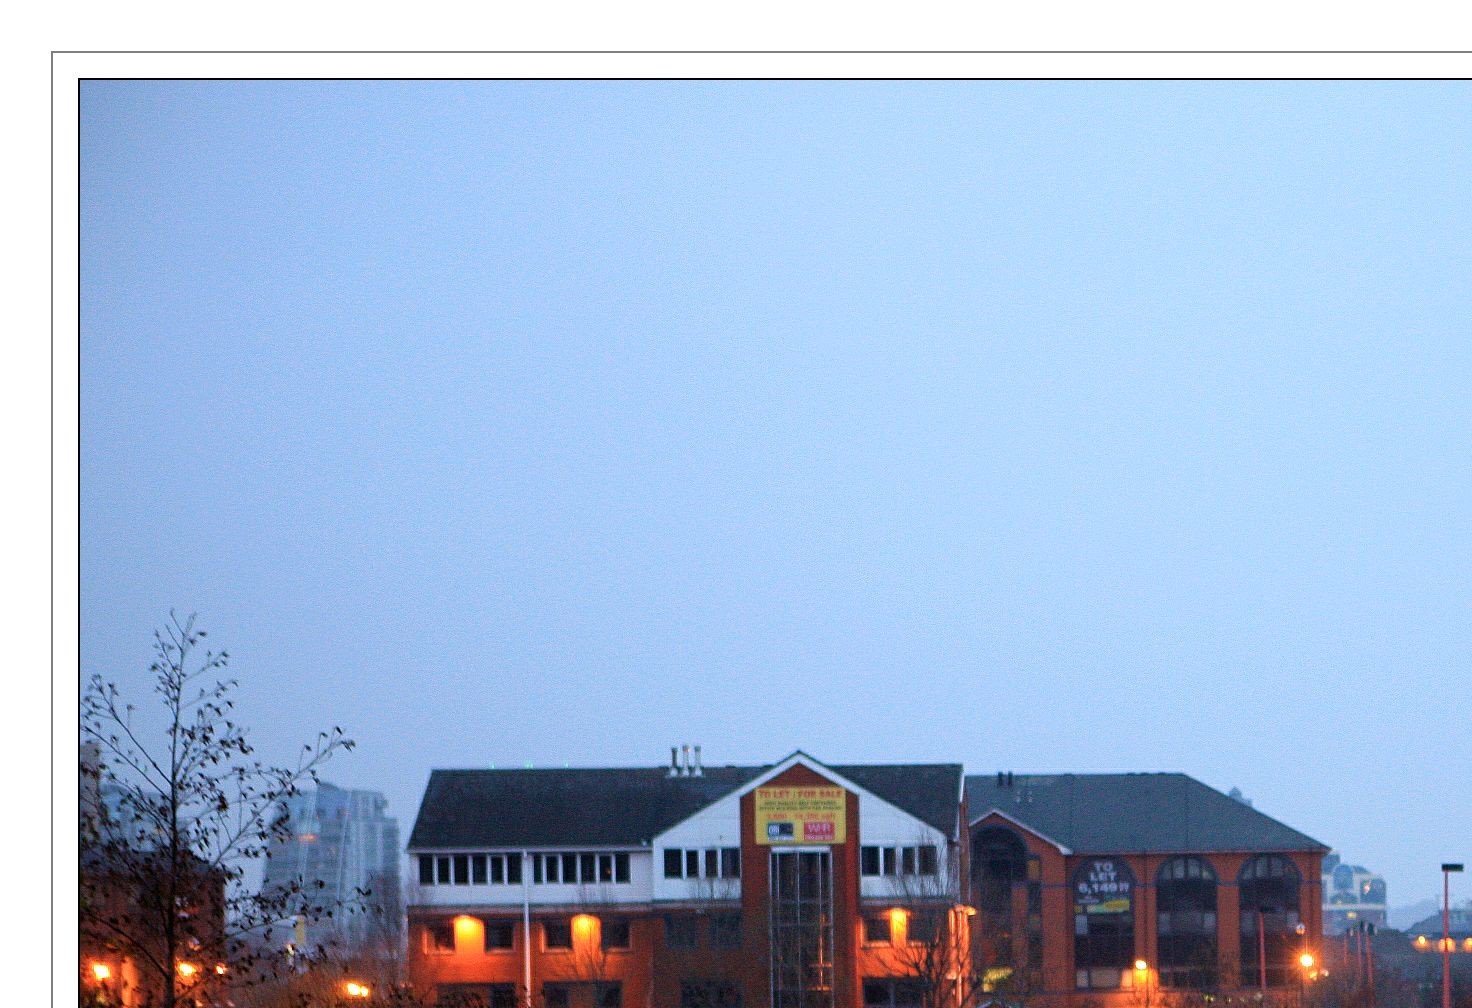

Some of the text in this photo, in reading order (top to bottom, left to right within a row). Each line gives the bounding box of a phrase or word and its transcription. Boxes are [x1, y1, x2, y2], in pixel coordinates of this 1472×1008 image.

[775, 789, 790, 798] LET
[798, 789, 817, 798] FOR
[820, 789, 842, 798] SALE
[1094, 862, 1114, 872] TO
[1090, 871, 1117, 881] LET
